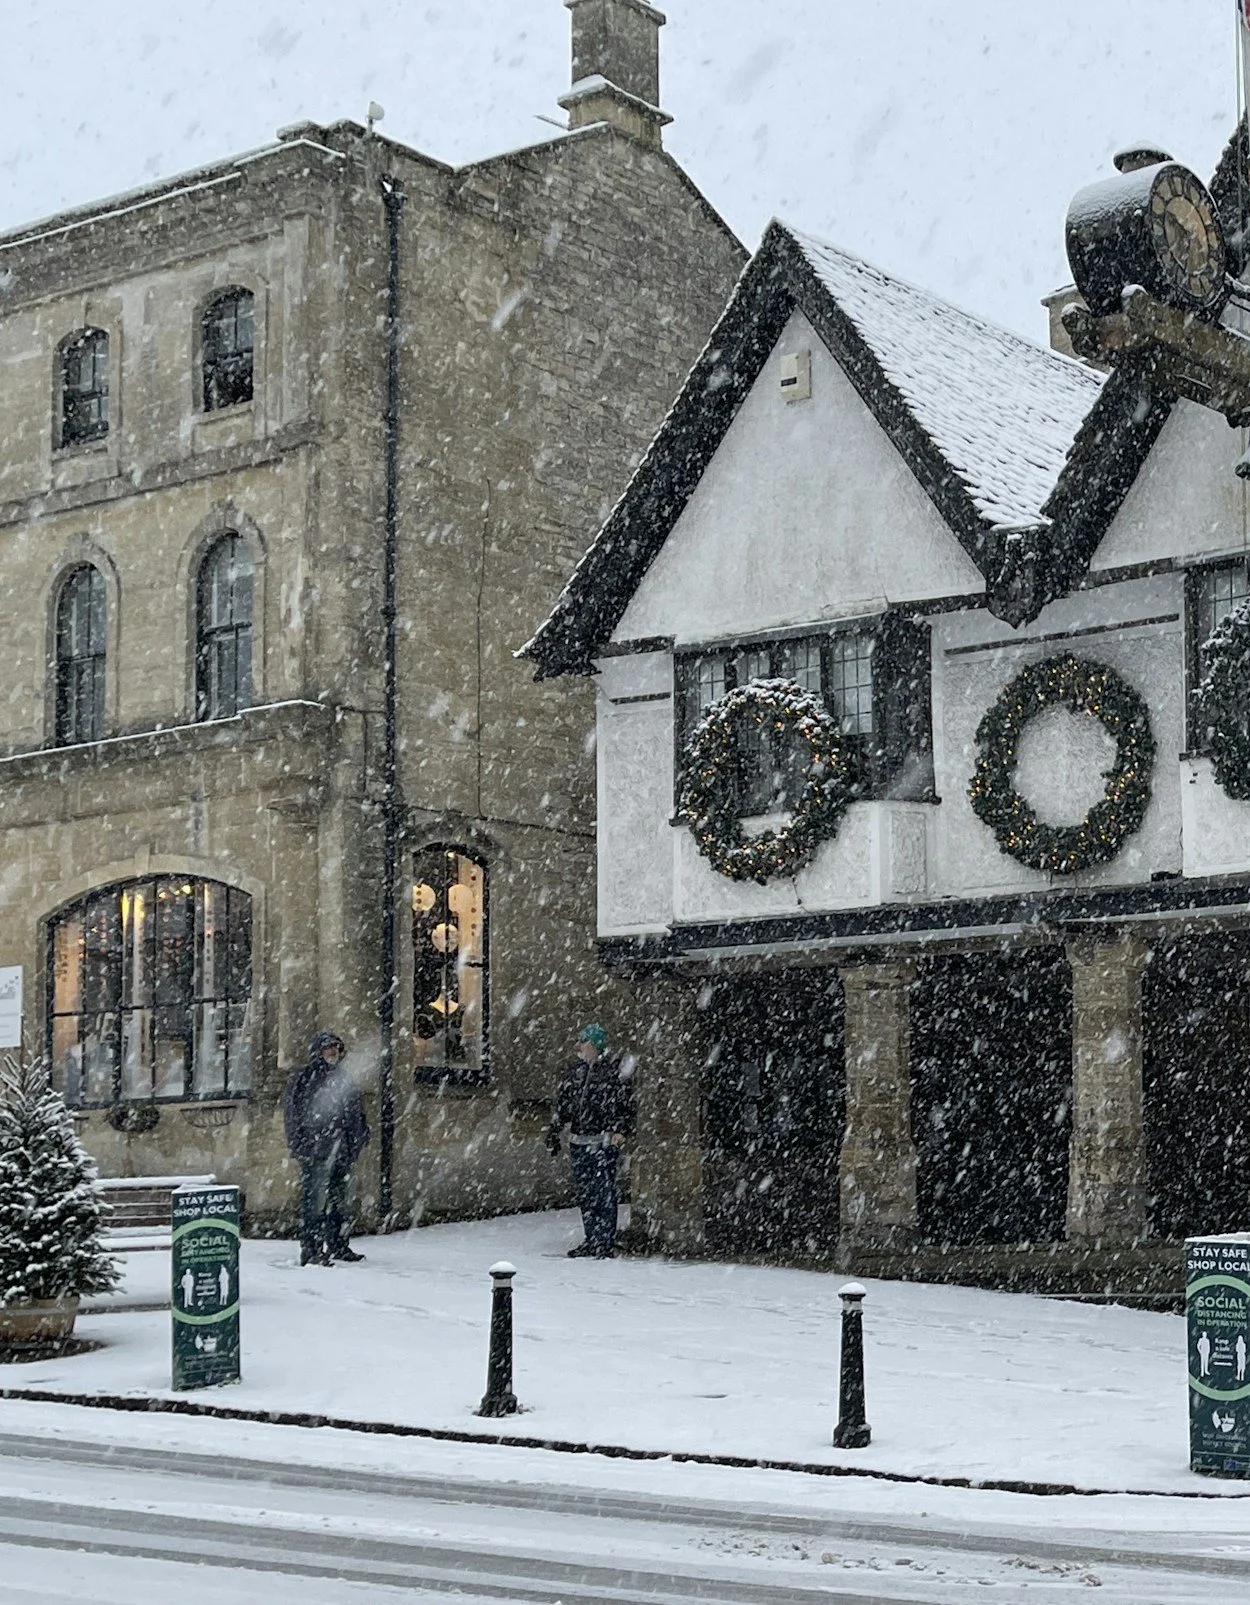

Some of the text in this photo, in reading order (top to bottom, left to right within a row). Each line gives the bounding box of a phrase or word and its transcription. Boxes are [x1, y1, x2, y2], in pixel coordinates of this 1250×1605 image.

[179, 1194, 233, 1206] STAY SAFE
[173, 1205, 237, 1217] SHOP LOCAL
[182, 1236, 230, 1249] SOCIAL
[1193, 1247, 1247, 1258] STAY SAFE
[1188, 1260, 1216, 1270] SHOP
[1197, 1296, 1246, 1309] SOCIAL
[1197, 1310, 1246, 1319] DISTANCING
